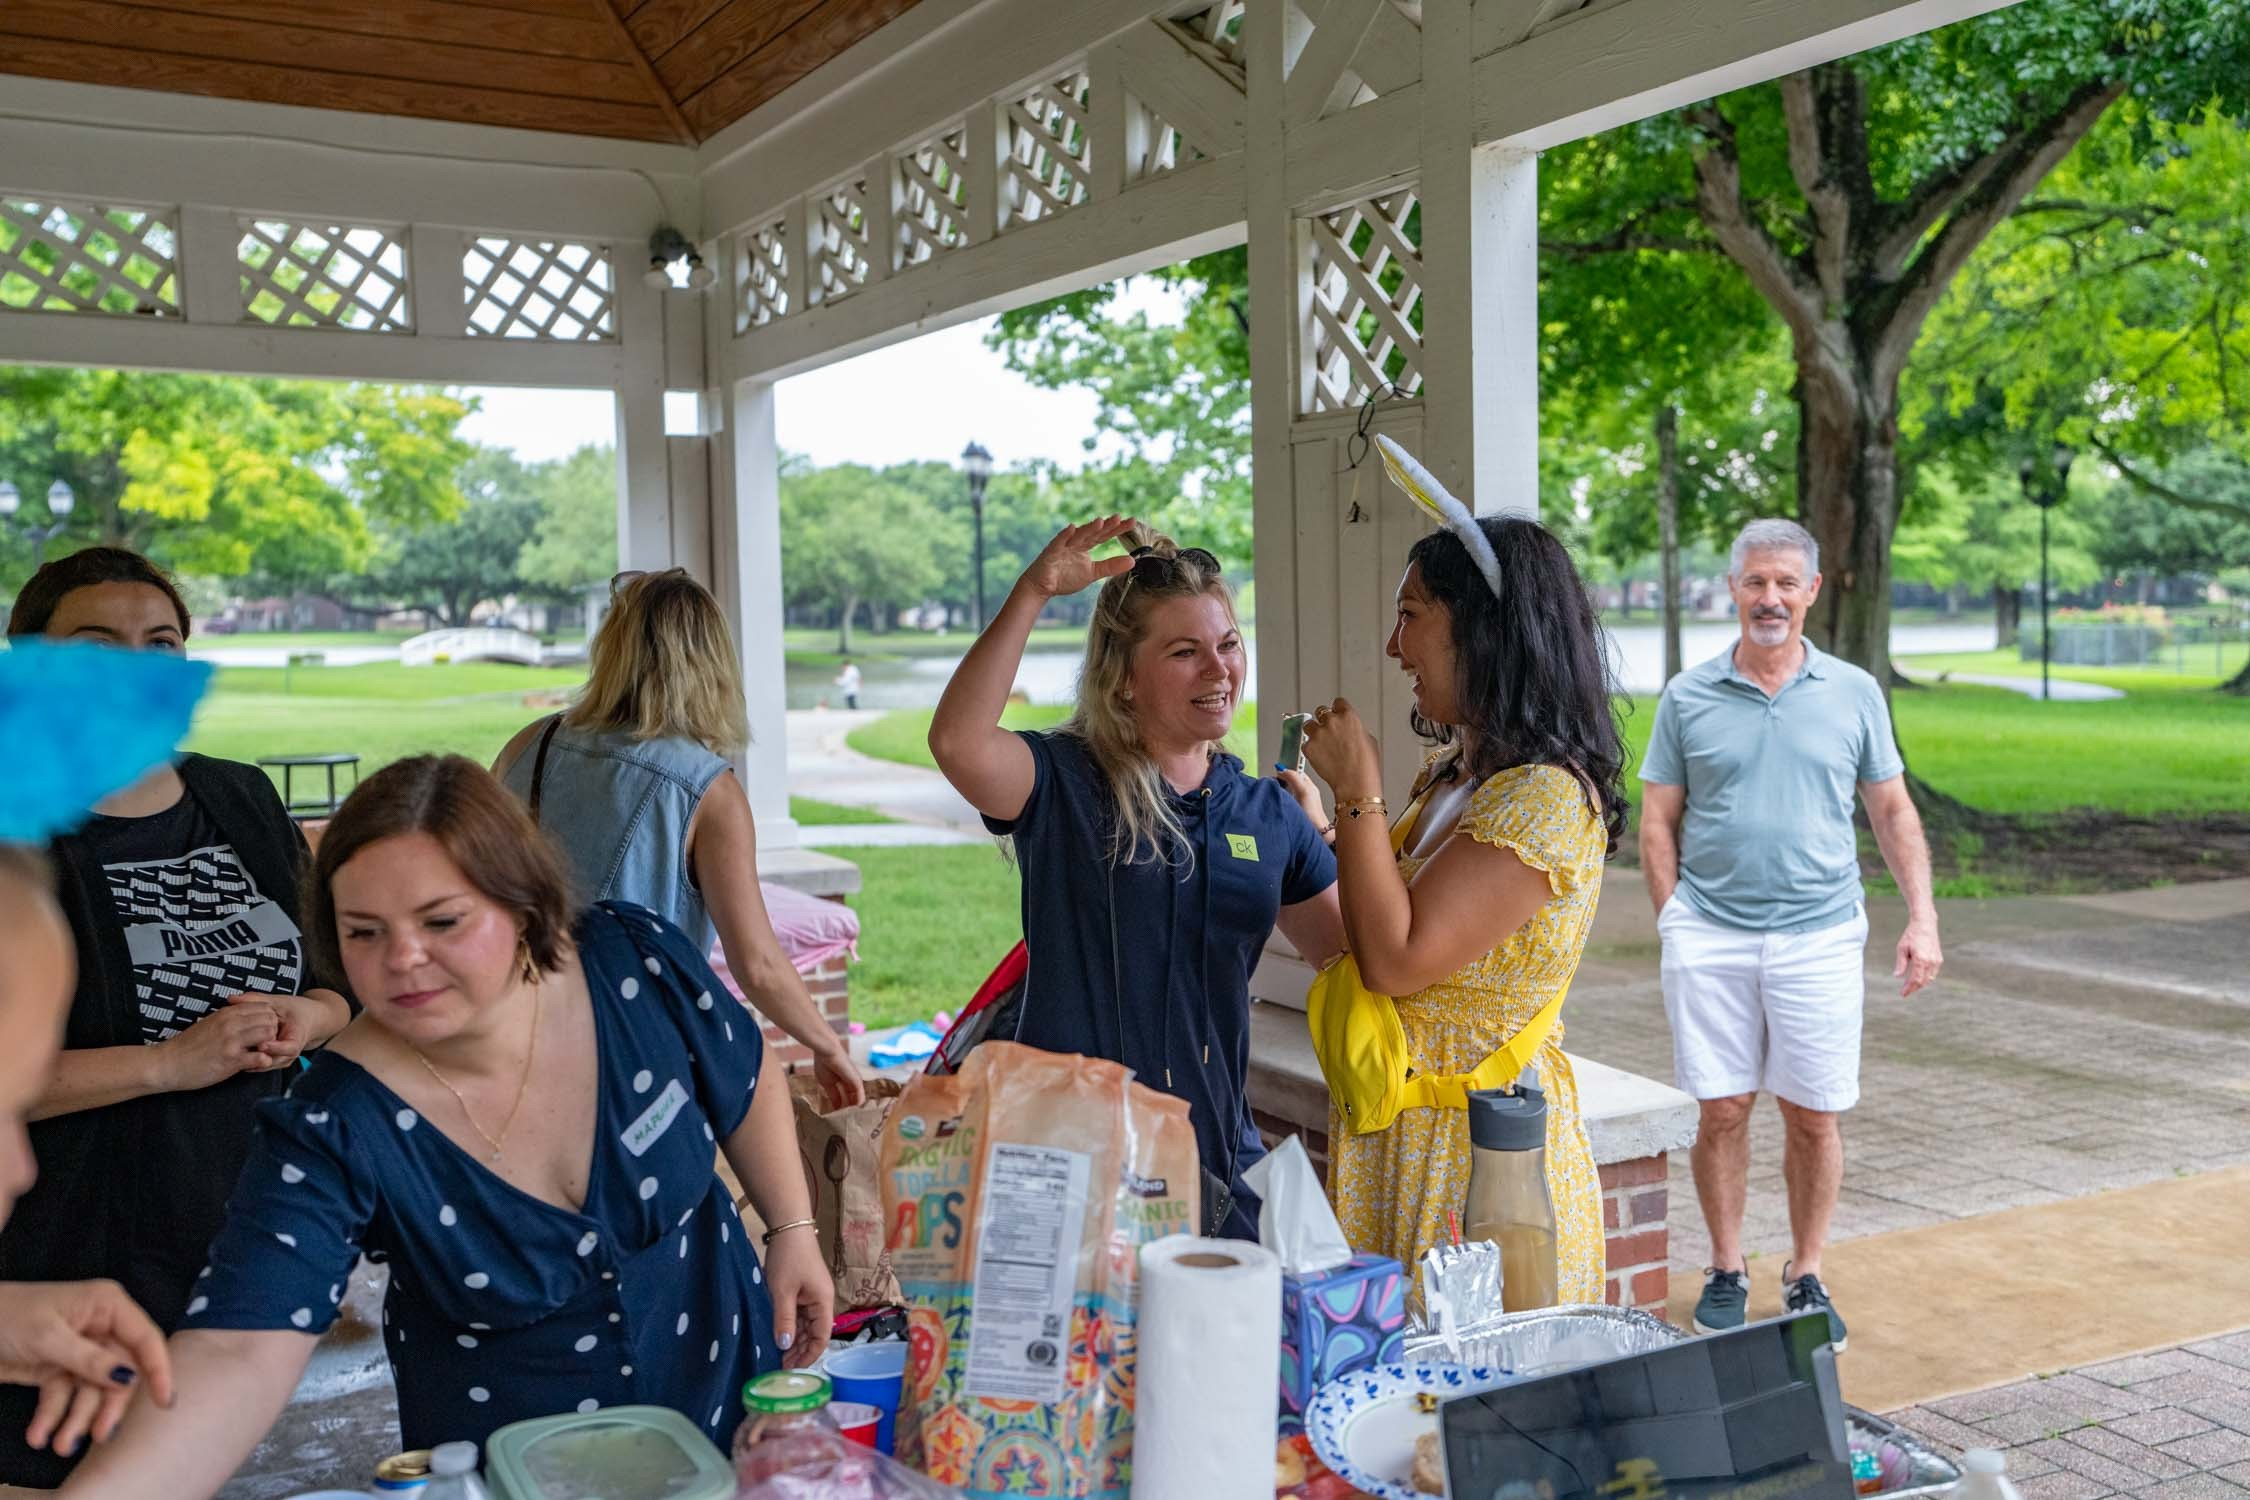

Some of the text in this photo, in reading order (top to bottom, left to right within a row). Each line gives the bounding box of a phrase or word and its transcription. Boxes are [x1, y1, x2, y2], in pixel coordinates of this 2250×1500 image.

[160, 919, 261, 958] PUMA
[151, 969, 190, 989] PUMA
[190, 962, 226, 980] PUMA
